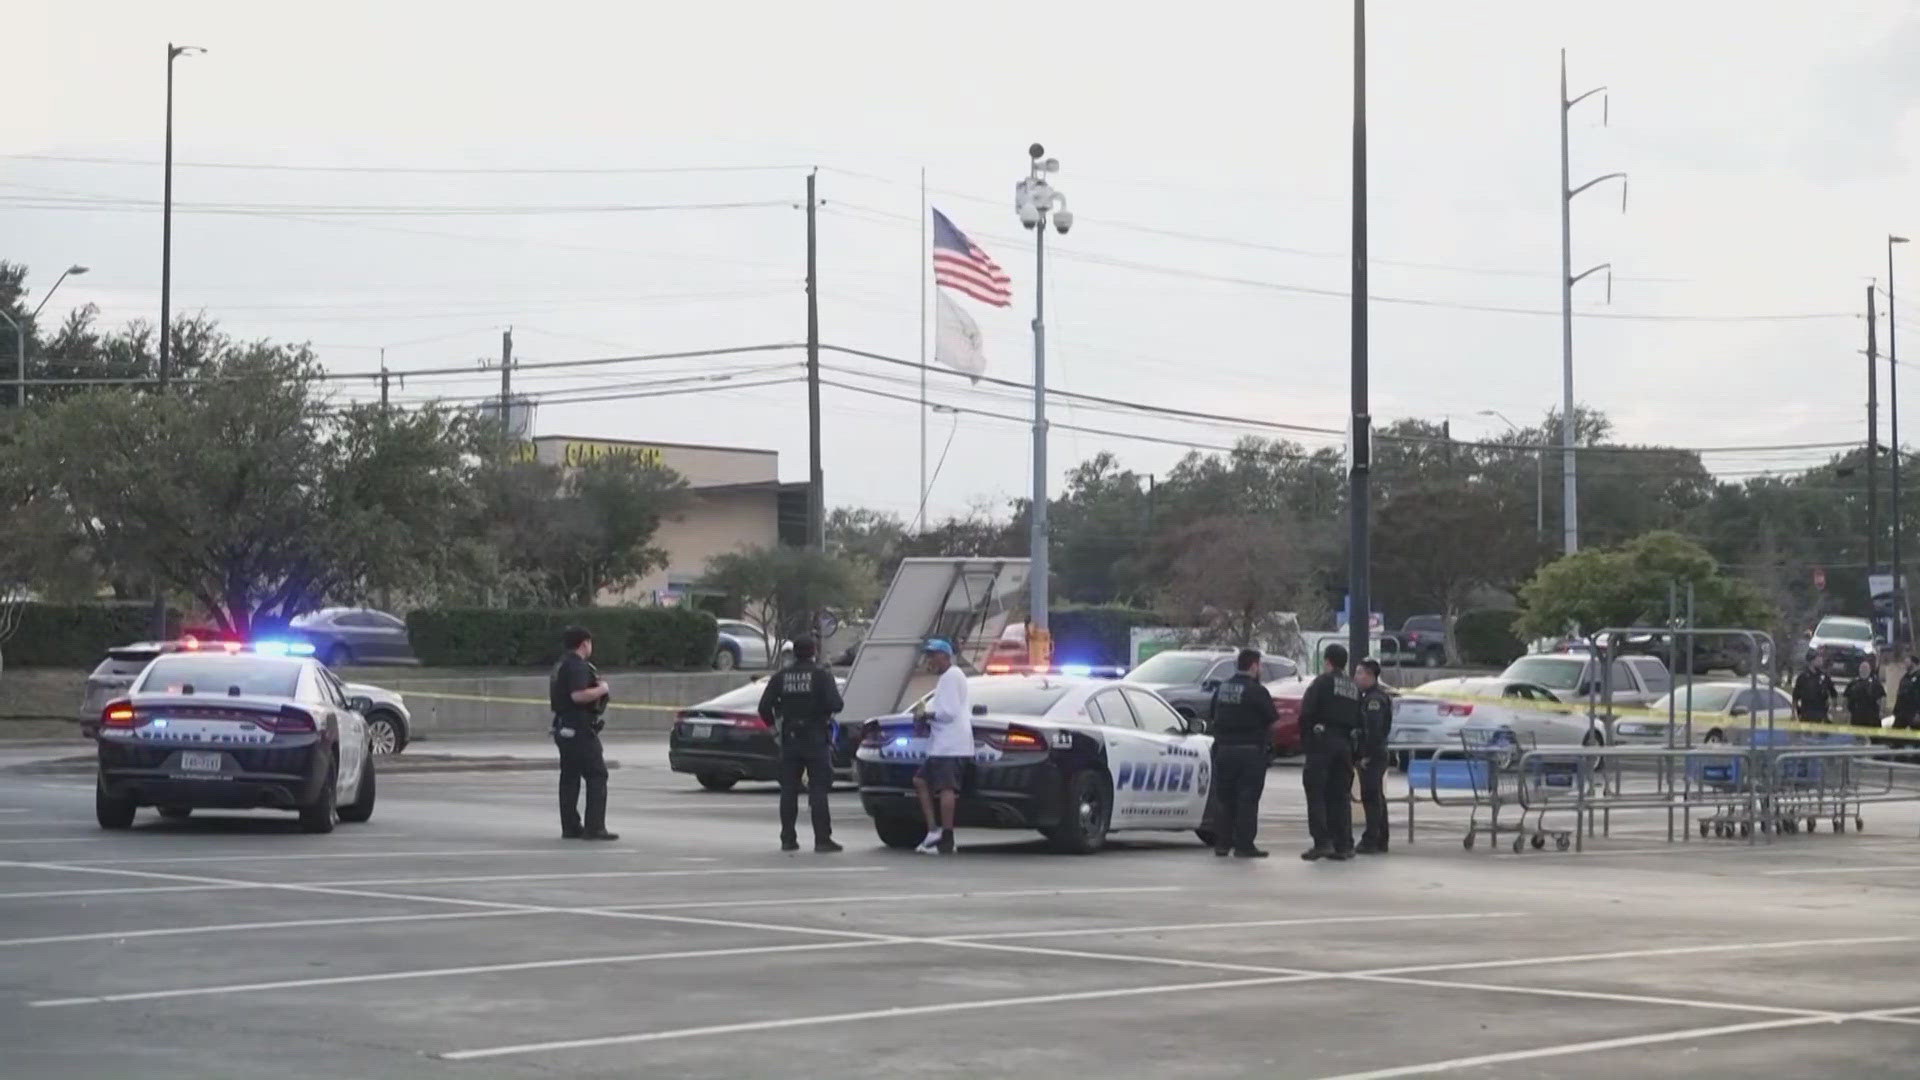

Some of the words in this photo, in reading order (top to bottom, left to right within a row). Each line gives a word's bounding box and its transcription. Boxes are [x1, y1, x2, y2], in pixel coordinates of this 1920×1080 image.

[784, 671, 812, 681] DALLAS
[784, 682, 811, 692] POLICE
[142, 732, 201, 742] DALLAS
[210, 734, 268, 743] POLICE
[887, 751, 935, 760] DALLA
[1167, 744, 1199, 758] DALLAS
[1116, 761, 1194, 792] POLICE
